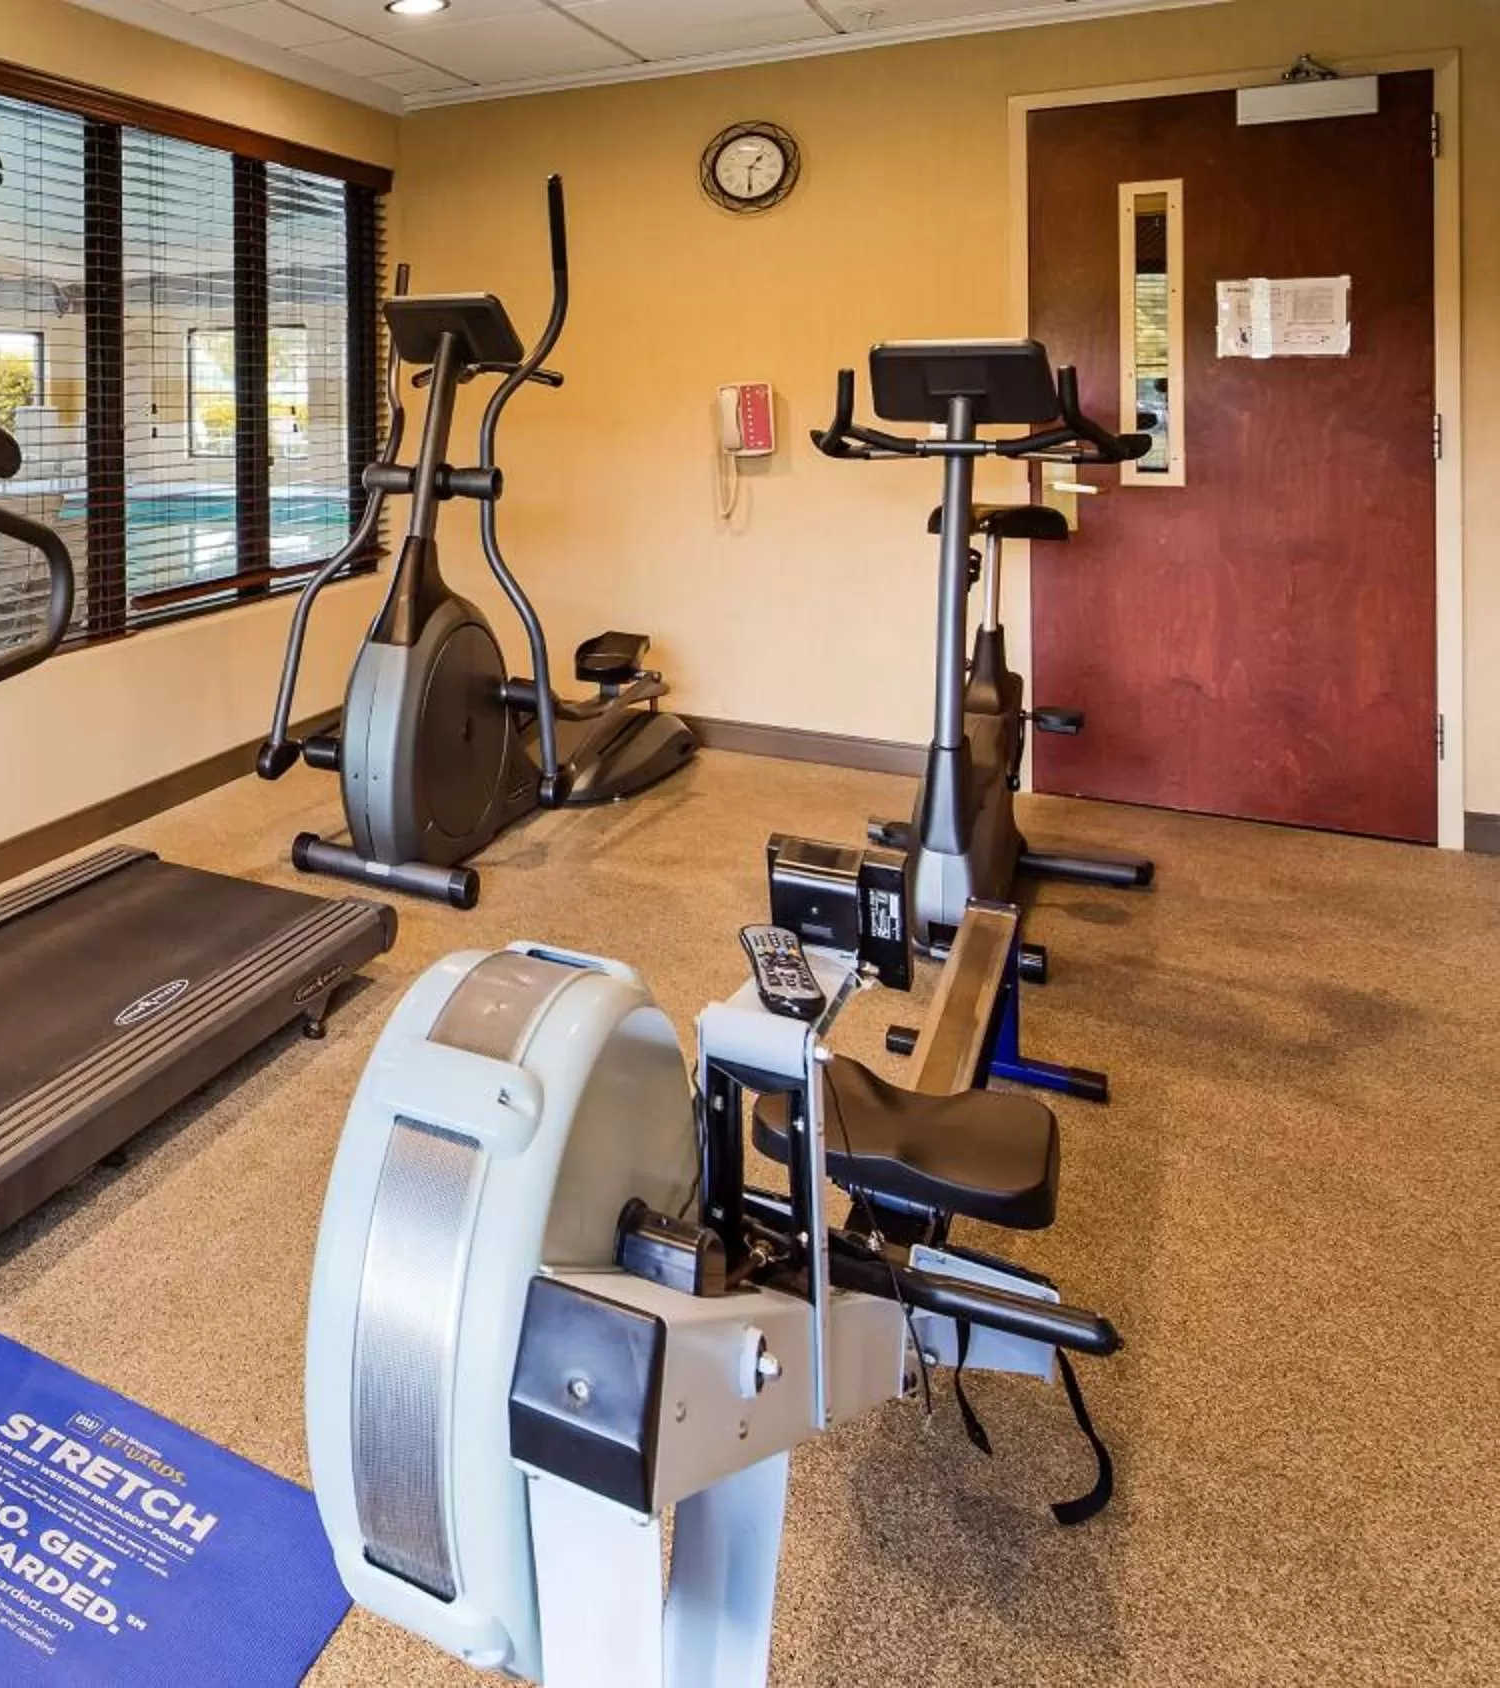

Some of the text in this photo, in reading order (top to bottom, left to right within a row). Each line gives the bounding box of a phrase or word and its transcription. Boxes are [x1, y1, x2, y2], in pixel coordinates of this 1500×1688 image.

[11, 1449, 39, 1468] BEST
[151, 1527, 195, 1555] POINTS
[39, 1528, 117, 1587] GET.
